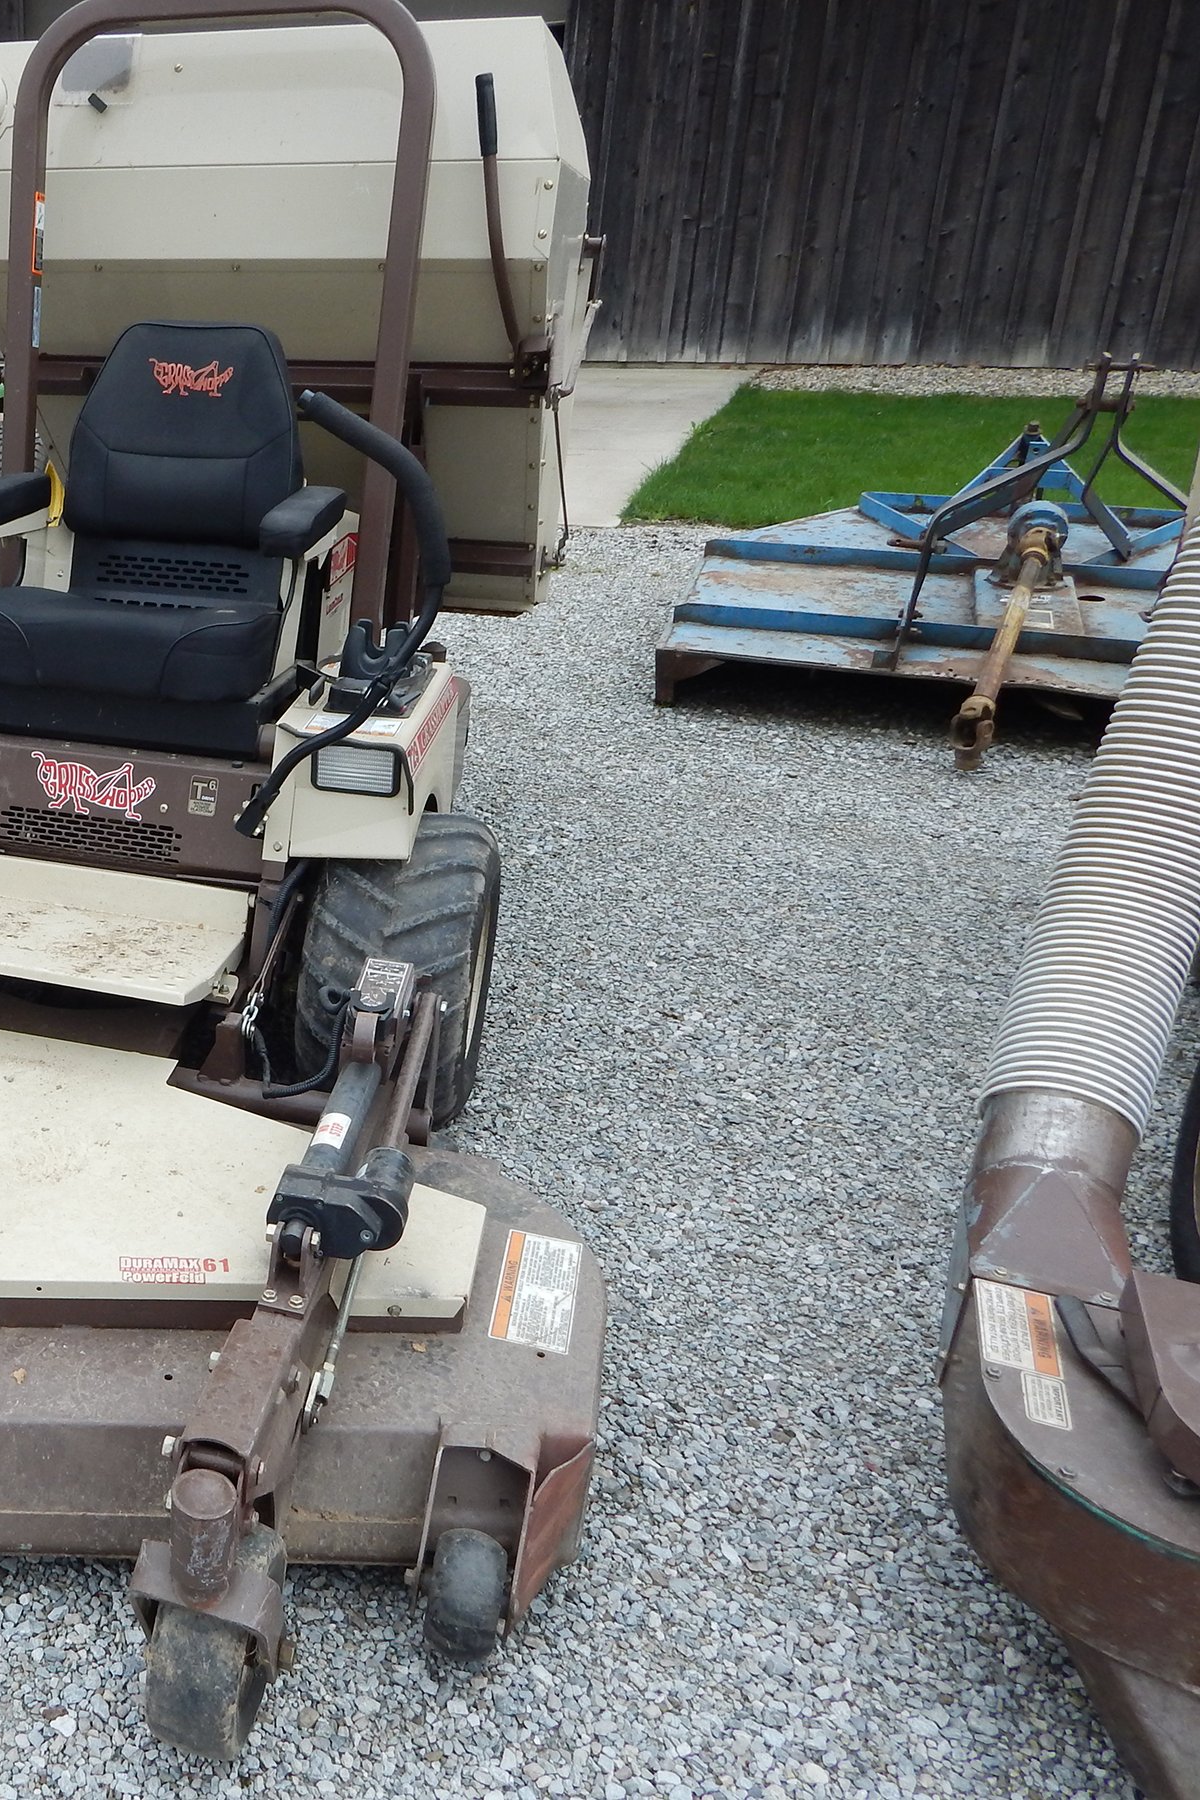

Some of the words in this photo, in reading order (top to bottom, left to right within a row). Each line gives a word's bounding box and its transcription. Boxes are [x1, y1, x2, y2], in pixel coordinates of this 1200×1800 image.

[36, 757, 157, 811] GRASSHOPPER
[202, 1258, 230, 1273] 61
[504, 1260, 518, 1293] WARNING
[1036, 1318, 1052, 1360] WARNING
